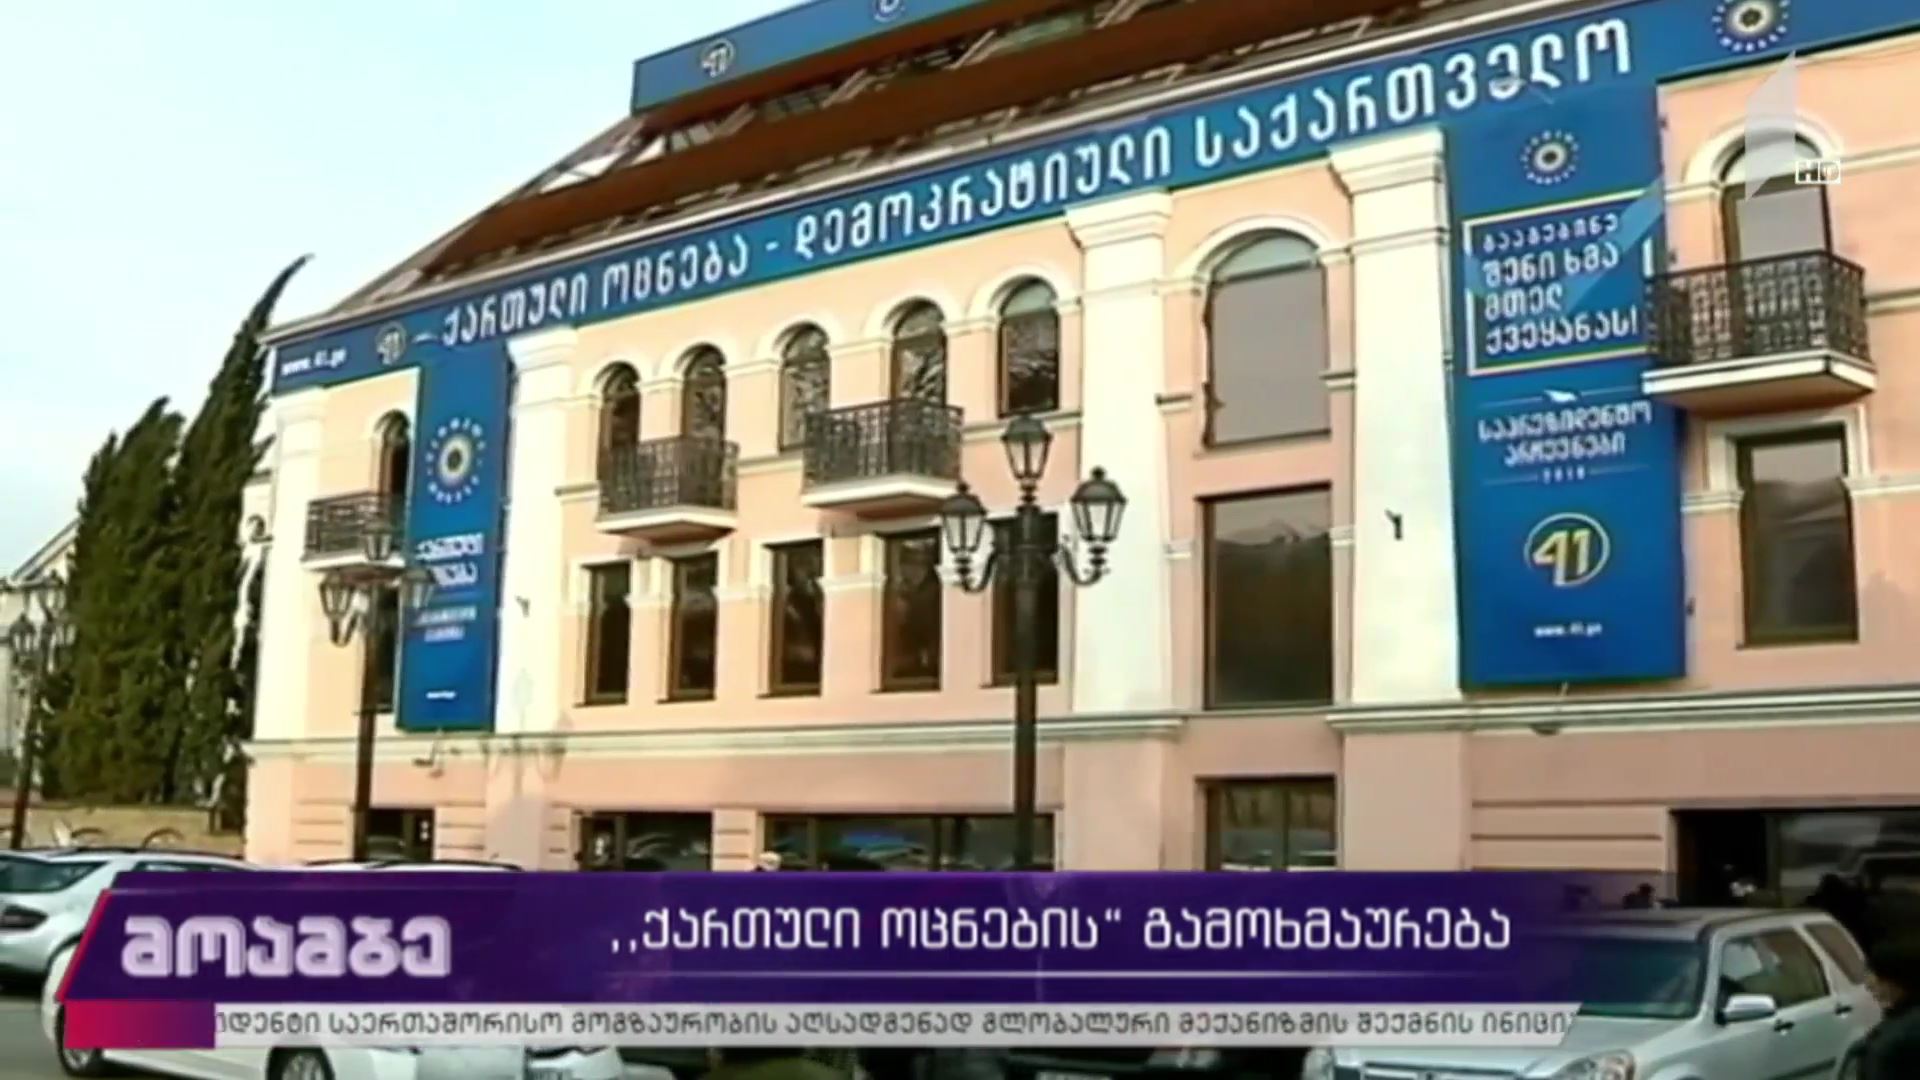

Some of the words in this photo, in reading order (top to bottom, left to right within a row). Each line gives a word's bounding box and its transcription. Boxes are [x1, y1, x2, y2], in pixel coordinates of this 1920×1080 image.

[441, 273, 587, 345] ქართული
[602, 237, 749, 305] ოცნება
[795, 127, 1171, 259] დემოკრატიული
[1195, 18, 1631, 168] საქართველო
[1483, 250, 1555, 287] შენი
[1563, 241, 1620, 277] ხმა
[1484, 281, 1563, 321] მთელ
[1485, 303, 1638, 355] ქვეყანას!
[1533, 528, 1592, 587] 41
